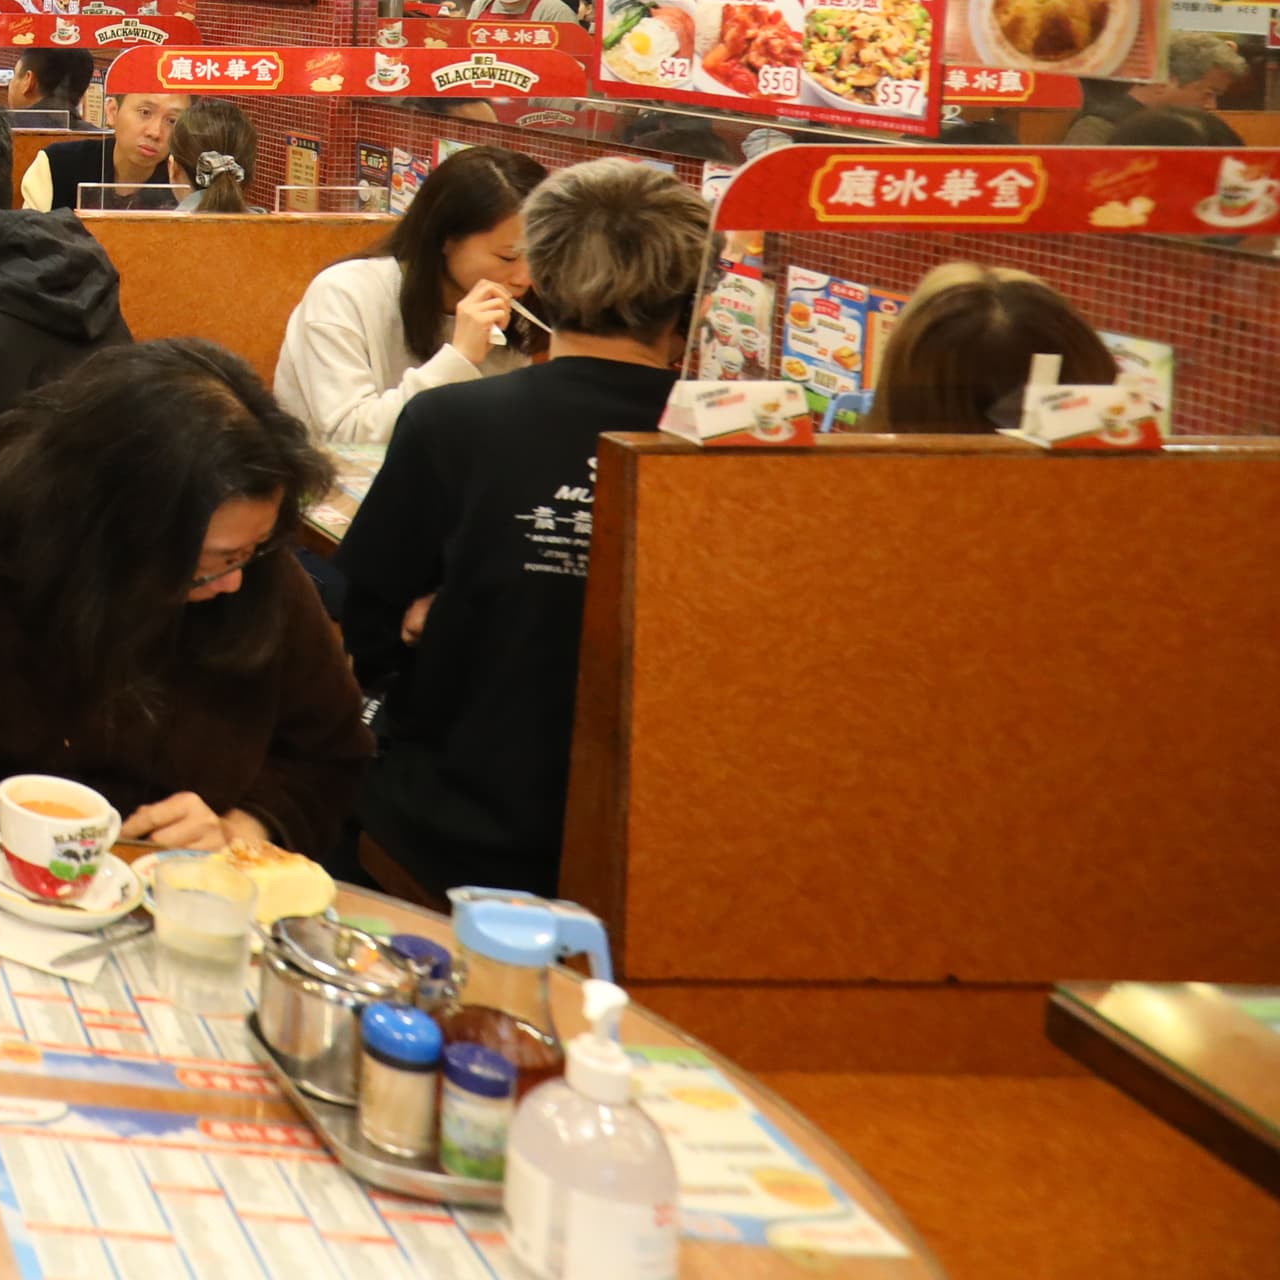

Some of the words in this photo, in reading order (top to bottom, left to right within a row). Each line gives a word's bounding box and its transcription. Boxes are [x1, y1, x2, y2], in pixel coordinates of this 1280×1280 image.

[97, 27, 165, 46] BLACK&WHITE
[167, 58, 278, 81] 金華冰廳
[435, 67, 534, 90] BLACK&WHITE
[659, 61, 688, 79] $42
[758, 70, 794, 93] $56
[880, 83, 920, 106] $57
[828, 166, 1037, 209] 金華冰廳
